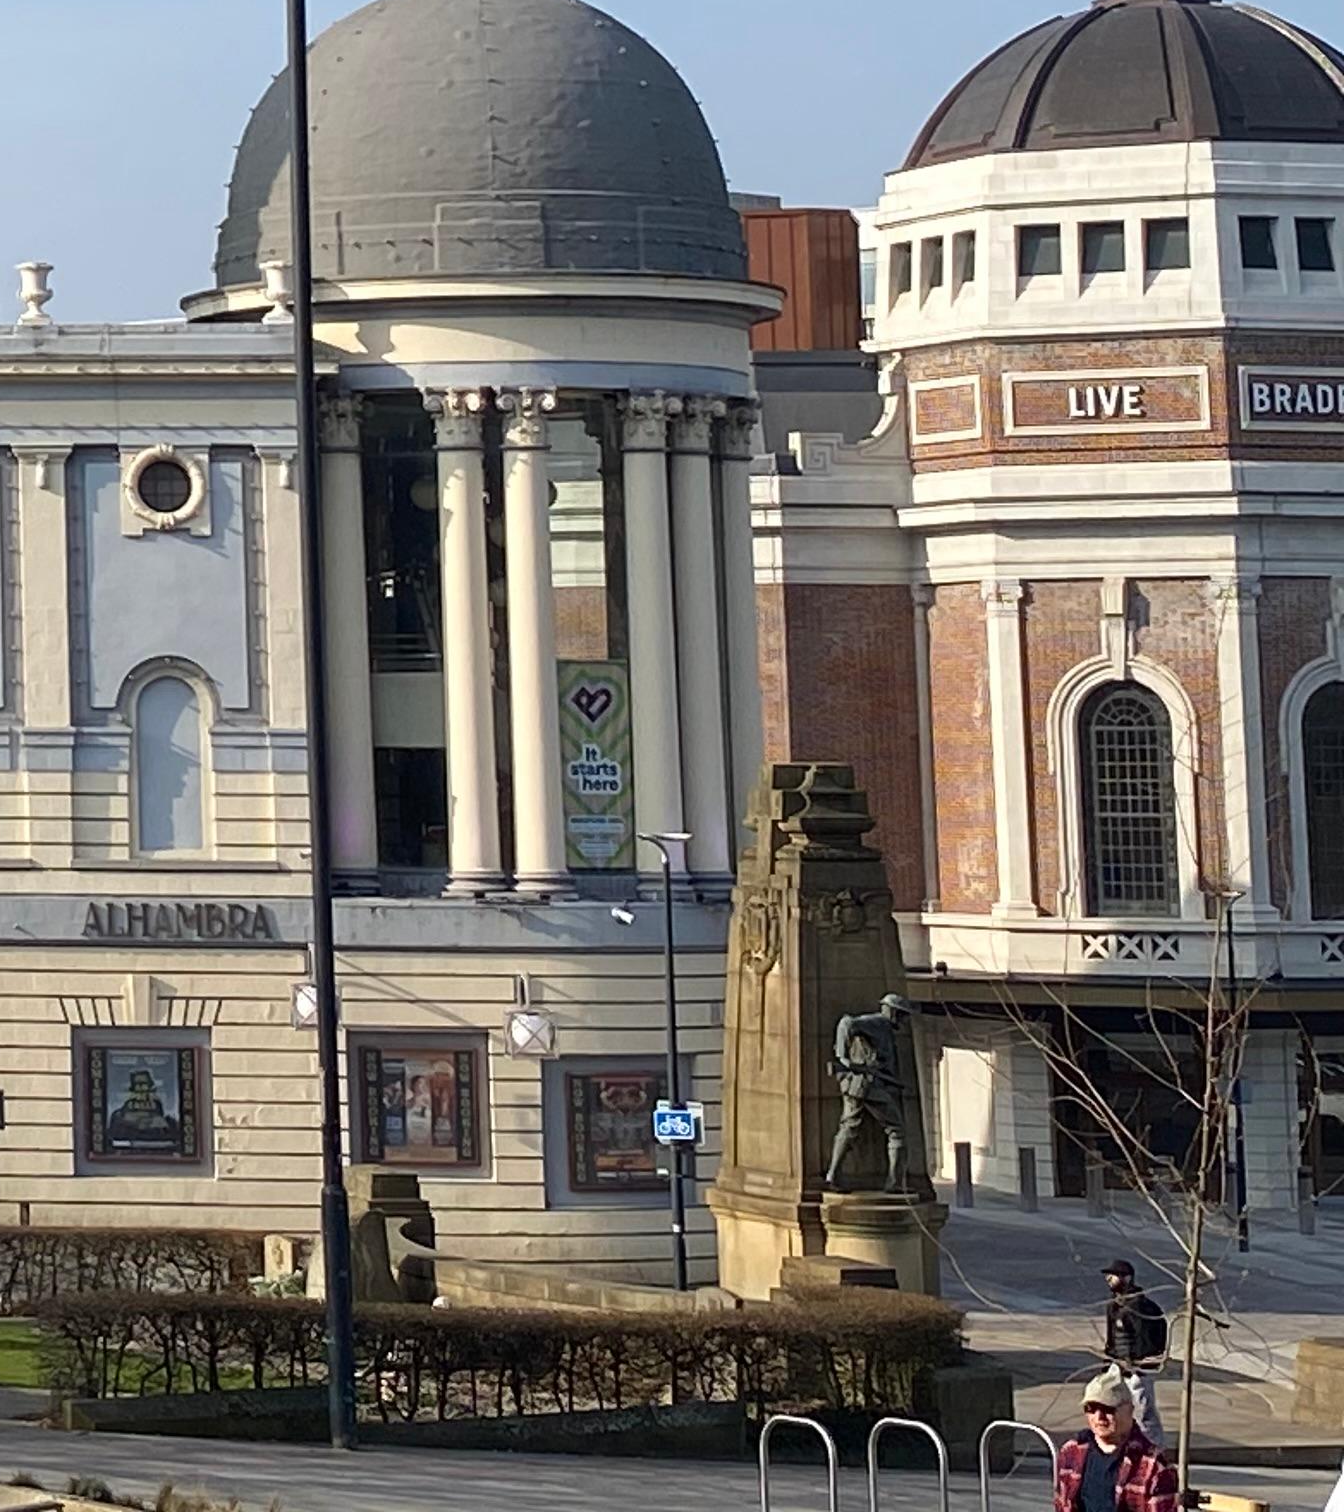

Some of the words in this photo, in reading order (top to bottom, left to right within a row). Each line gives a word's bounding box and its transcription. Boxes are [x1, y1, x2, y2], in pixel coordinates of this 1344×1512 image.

[1069, 385, 1145, 418] LIVE
[585, 747, 598, 761] It
[570, 762, 618, 776] starts
[582, 776, 619, 791] here
[83, 901, 275, 940] ALHAMBRA
